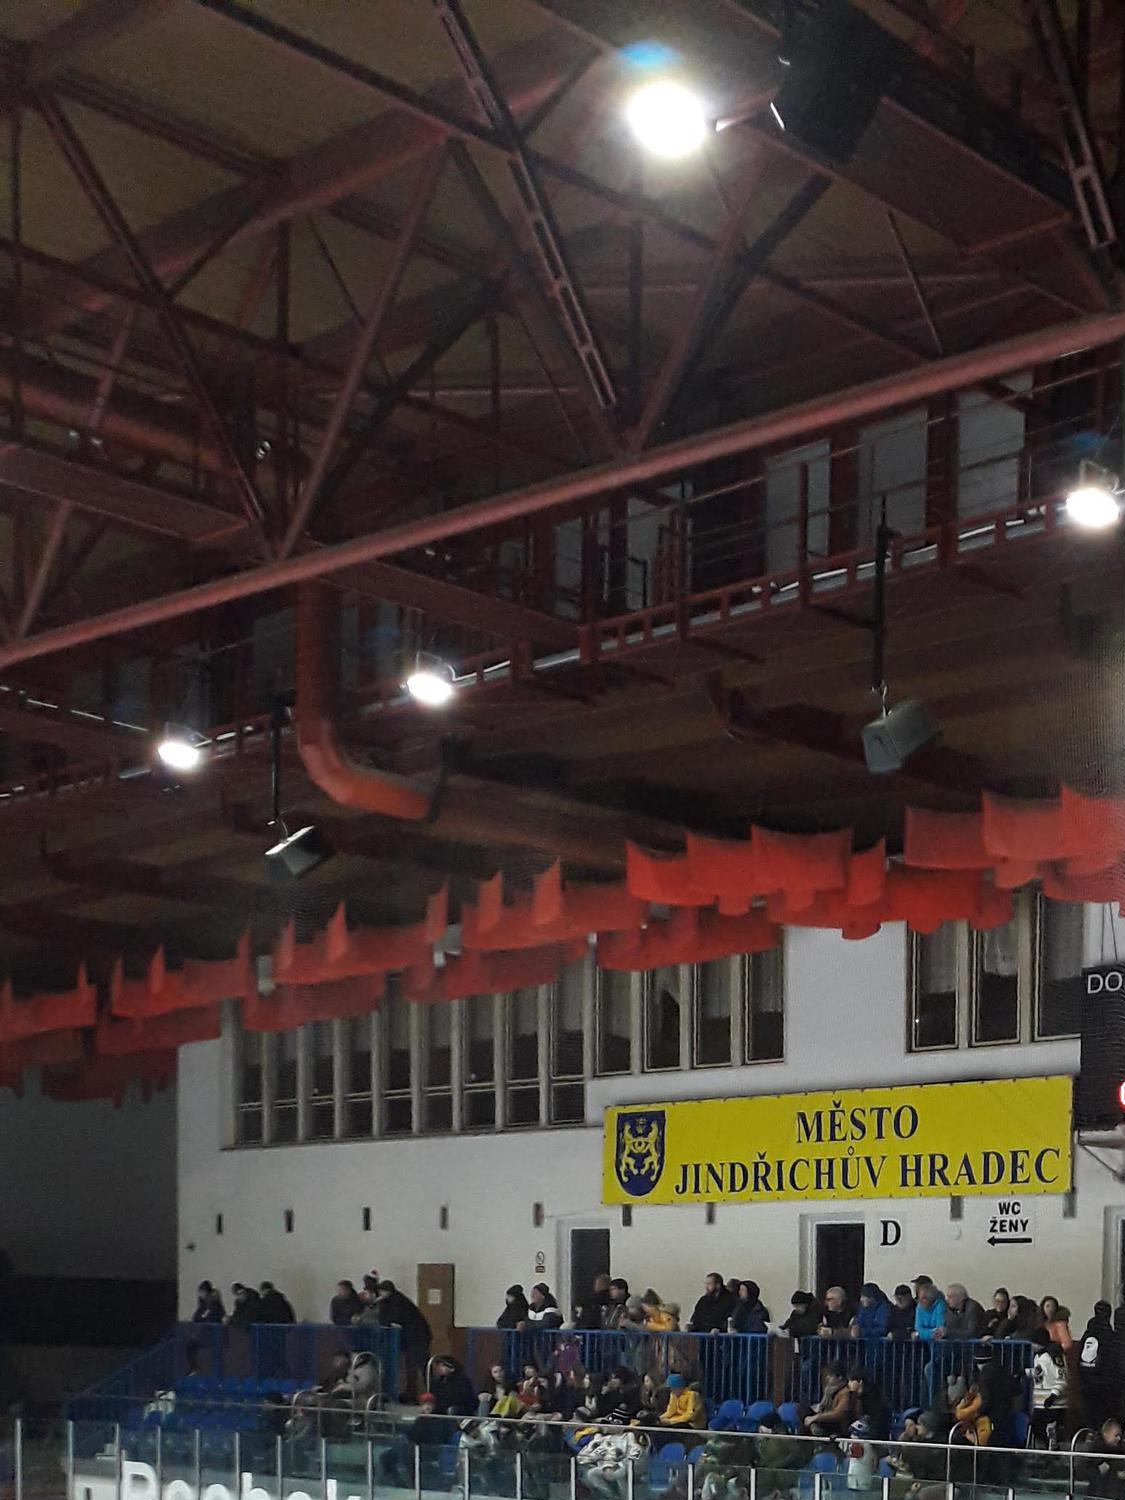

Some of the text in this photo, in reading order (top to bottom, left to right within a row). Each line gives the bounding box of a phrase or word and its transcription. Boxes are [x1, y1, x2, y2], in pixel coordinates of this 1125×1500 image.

[796, 1100, 919, 1143] MĚSTO
[674, 1146, 1061, 1195] JINDŘICHŮV HRADEC
[998, 1202, 1021, 1215] WC
[880, 1220, 901, 1247] D
[989, 1217, 1029, 1233] ŽENY
